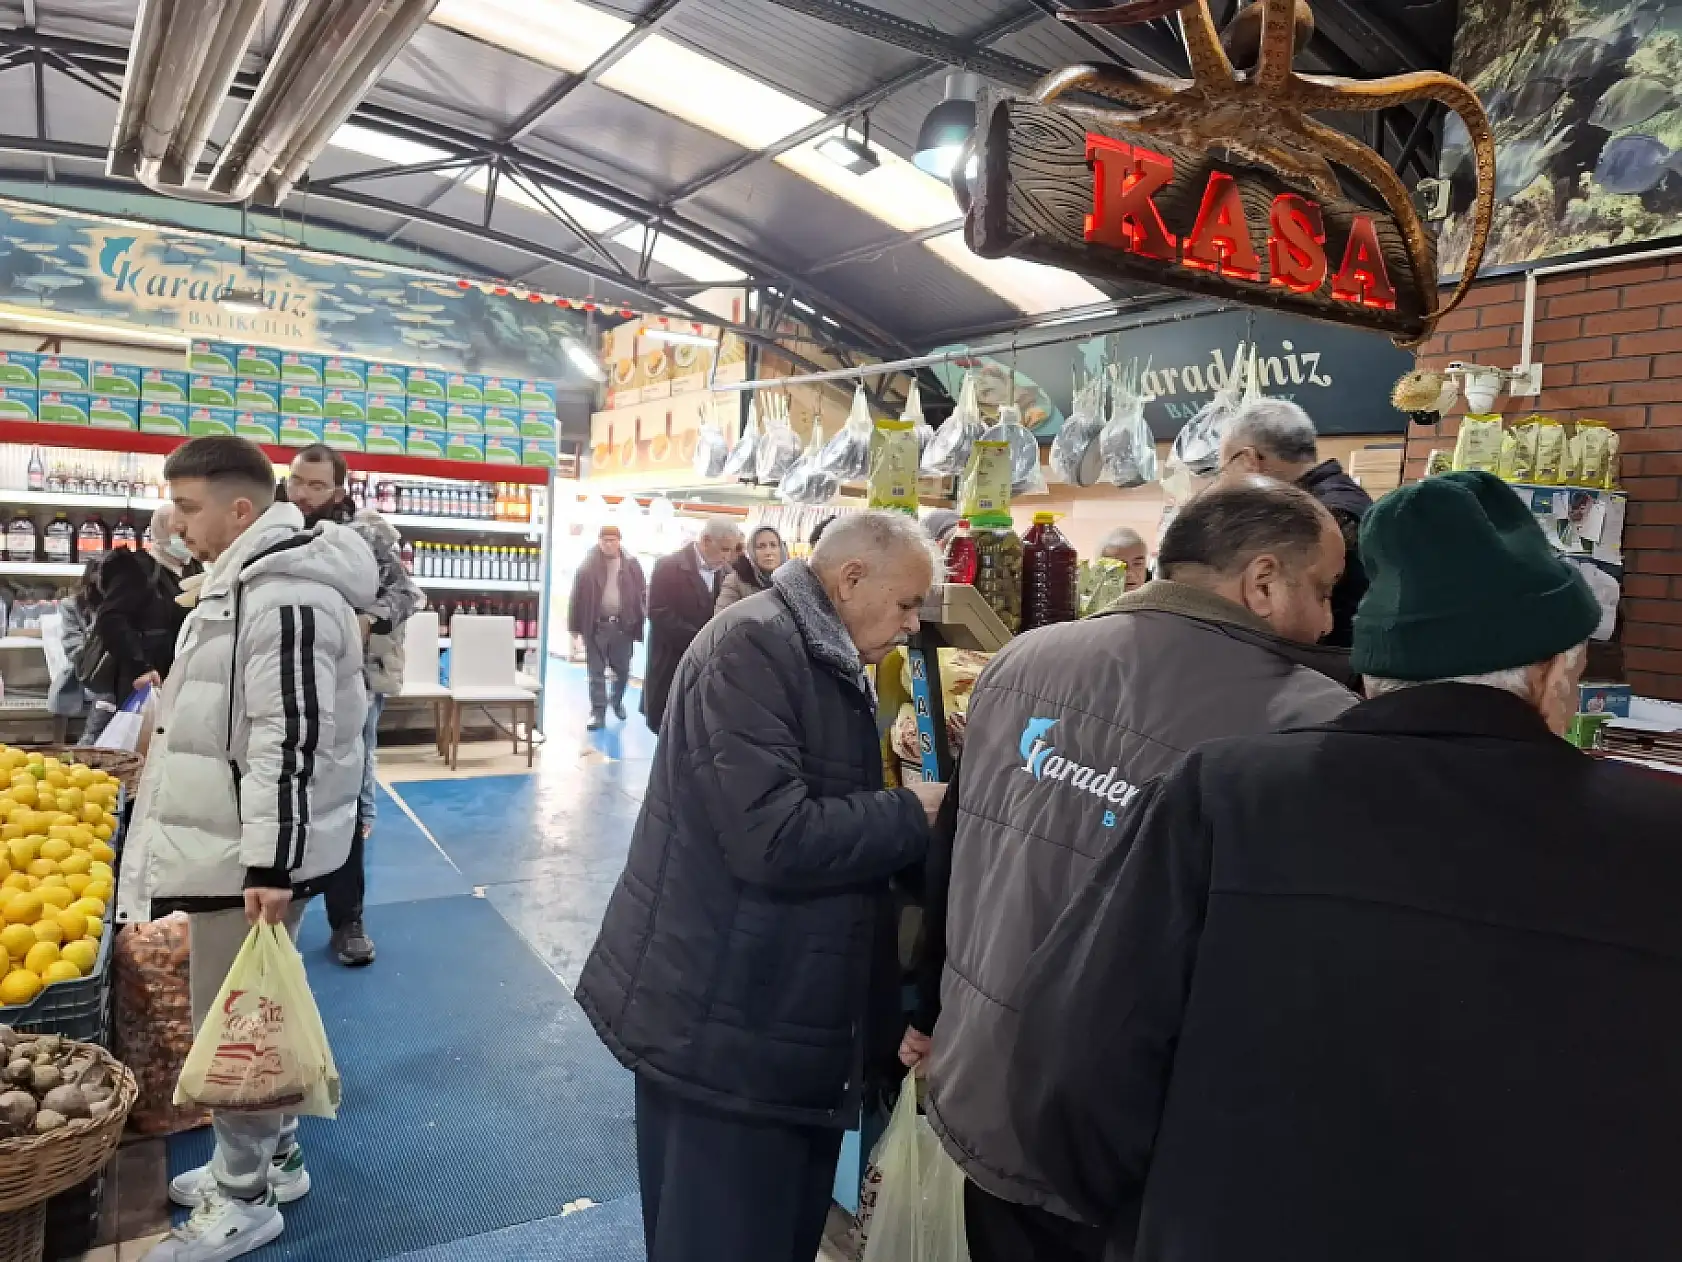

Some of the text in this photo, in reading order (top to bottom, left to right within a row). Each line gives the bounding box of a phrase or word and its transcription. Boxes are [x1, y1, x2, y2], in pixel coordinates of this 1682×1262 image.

[1084, 132, 1396, 310] KASA
[114, 260, 306, 318] Karadniz
[1108, 338, 1332, 402] aradniz
